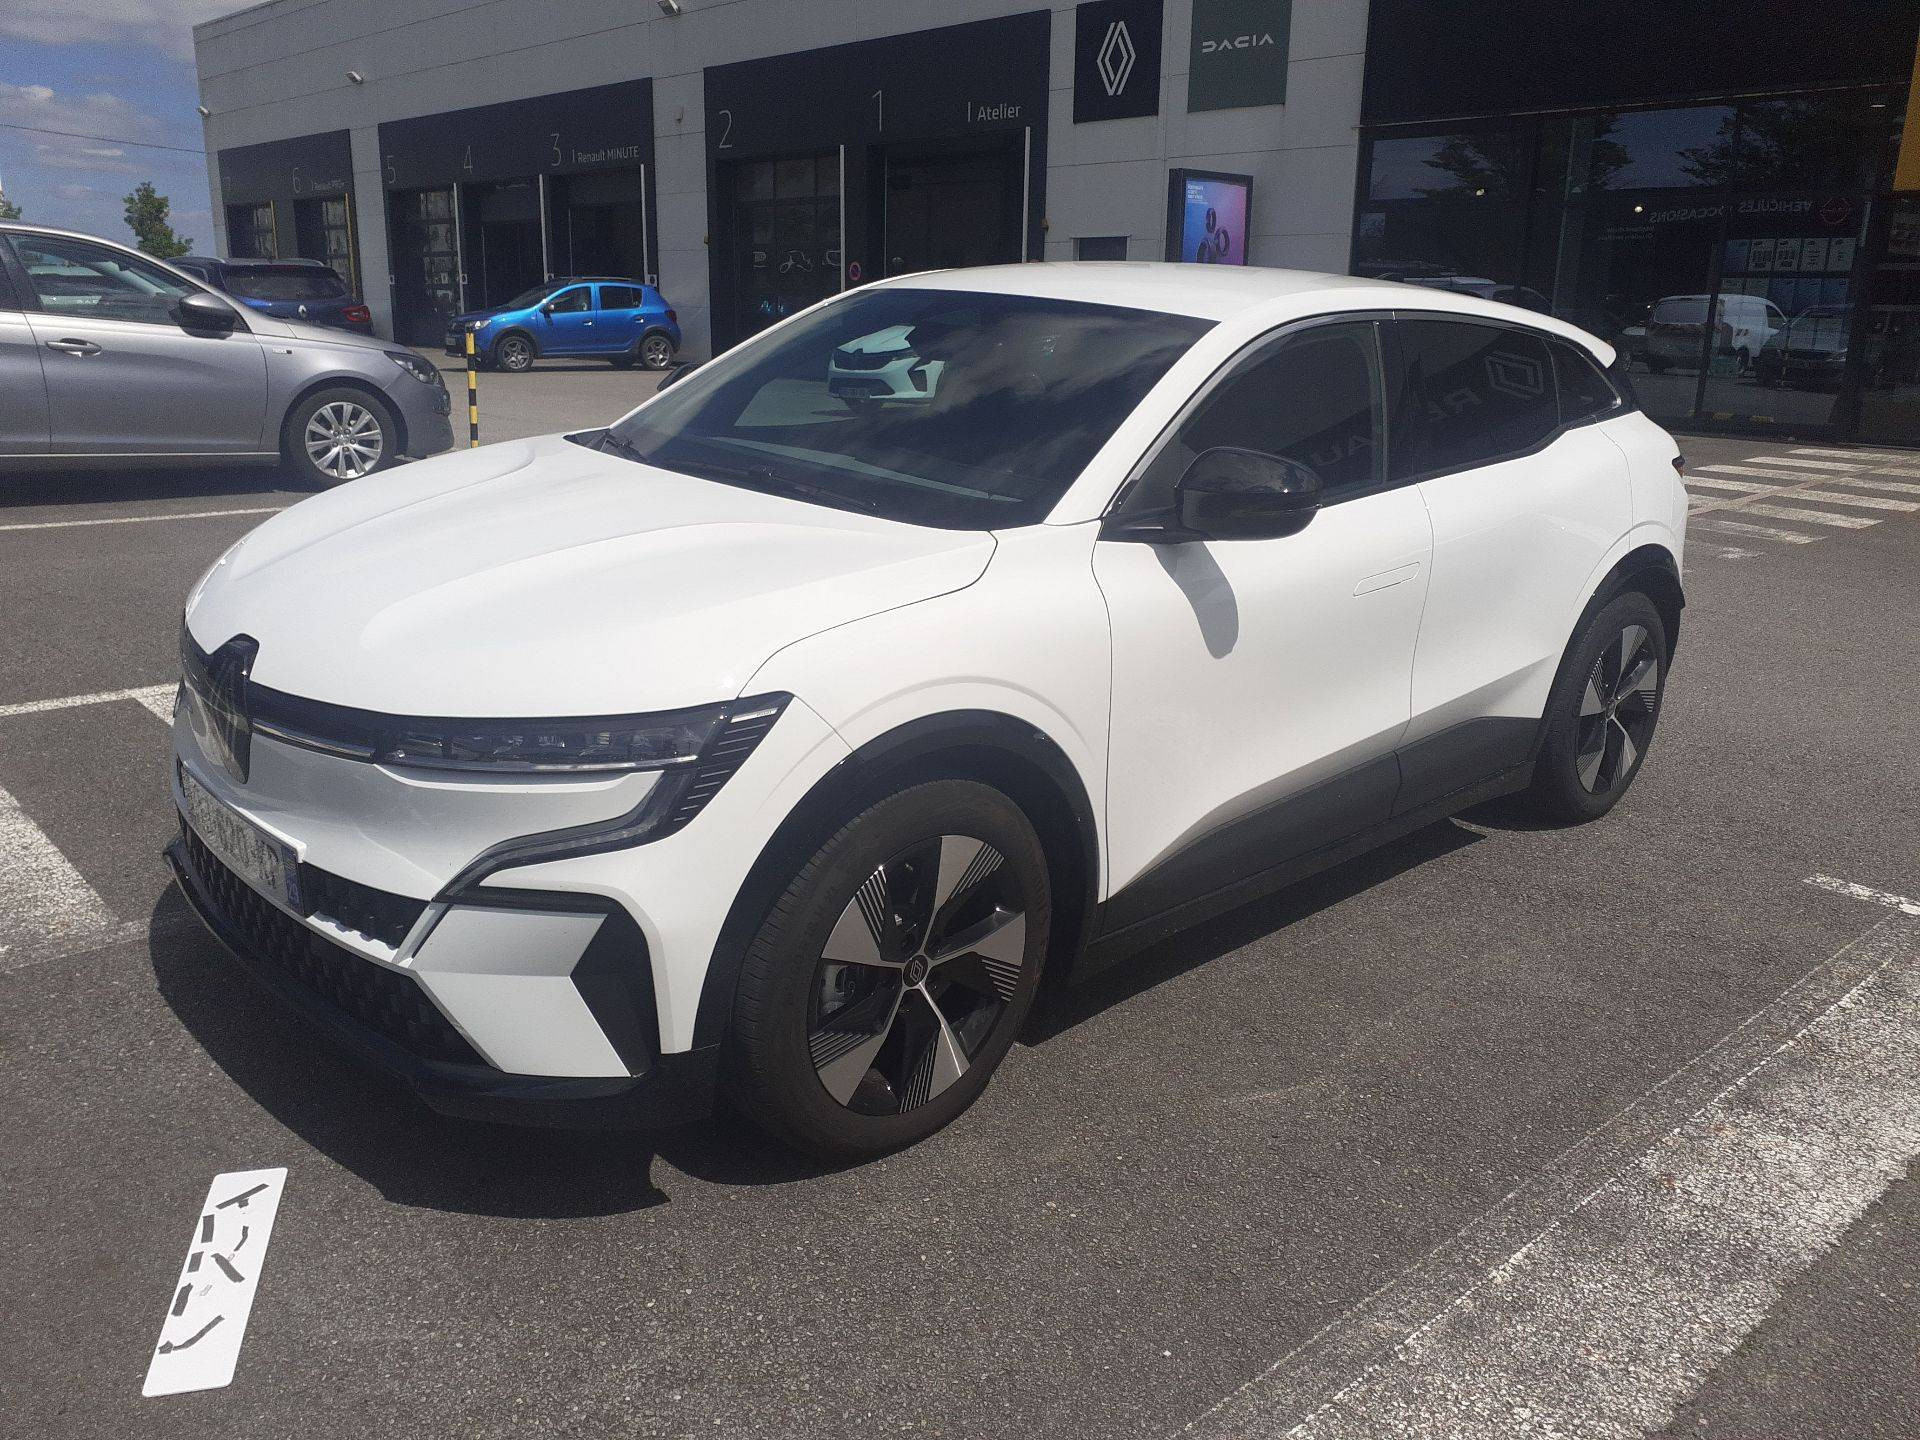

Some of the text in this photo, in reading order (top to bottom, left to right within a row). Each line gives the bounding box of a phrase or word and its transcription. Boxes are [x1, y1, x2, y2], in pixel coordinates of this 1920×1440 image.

[1202, 33, 1274, 54] DACIA
[872, 90, 882, 132] 1
[977, 103, 1021, 122] Atelier
[718, 110, 733, 148] 2
[463, 145, 474, 174] 4
[550, 133, 561, 166] 3
[577, 144, 640, 163] Renault MINUTE
[293, 167, 302, 193] 6
[386, 155, 397, 184] 5
